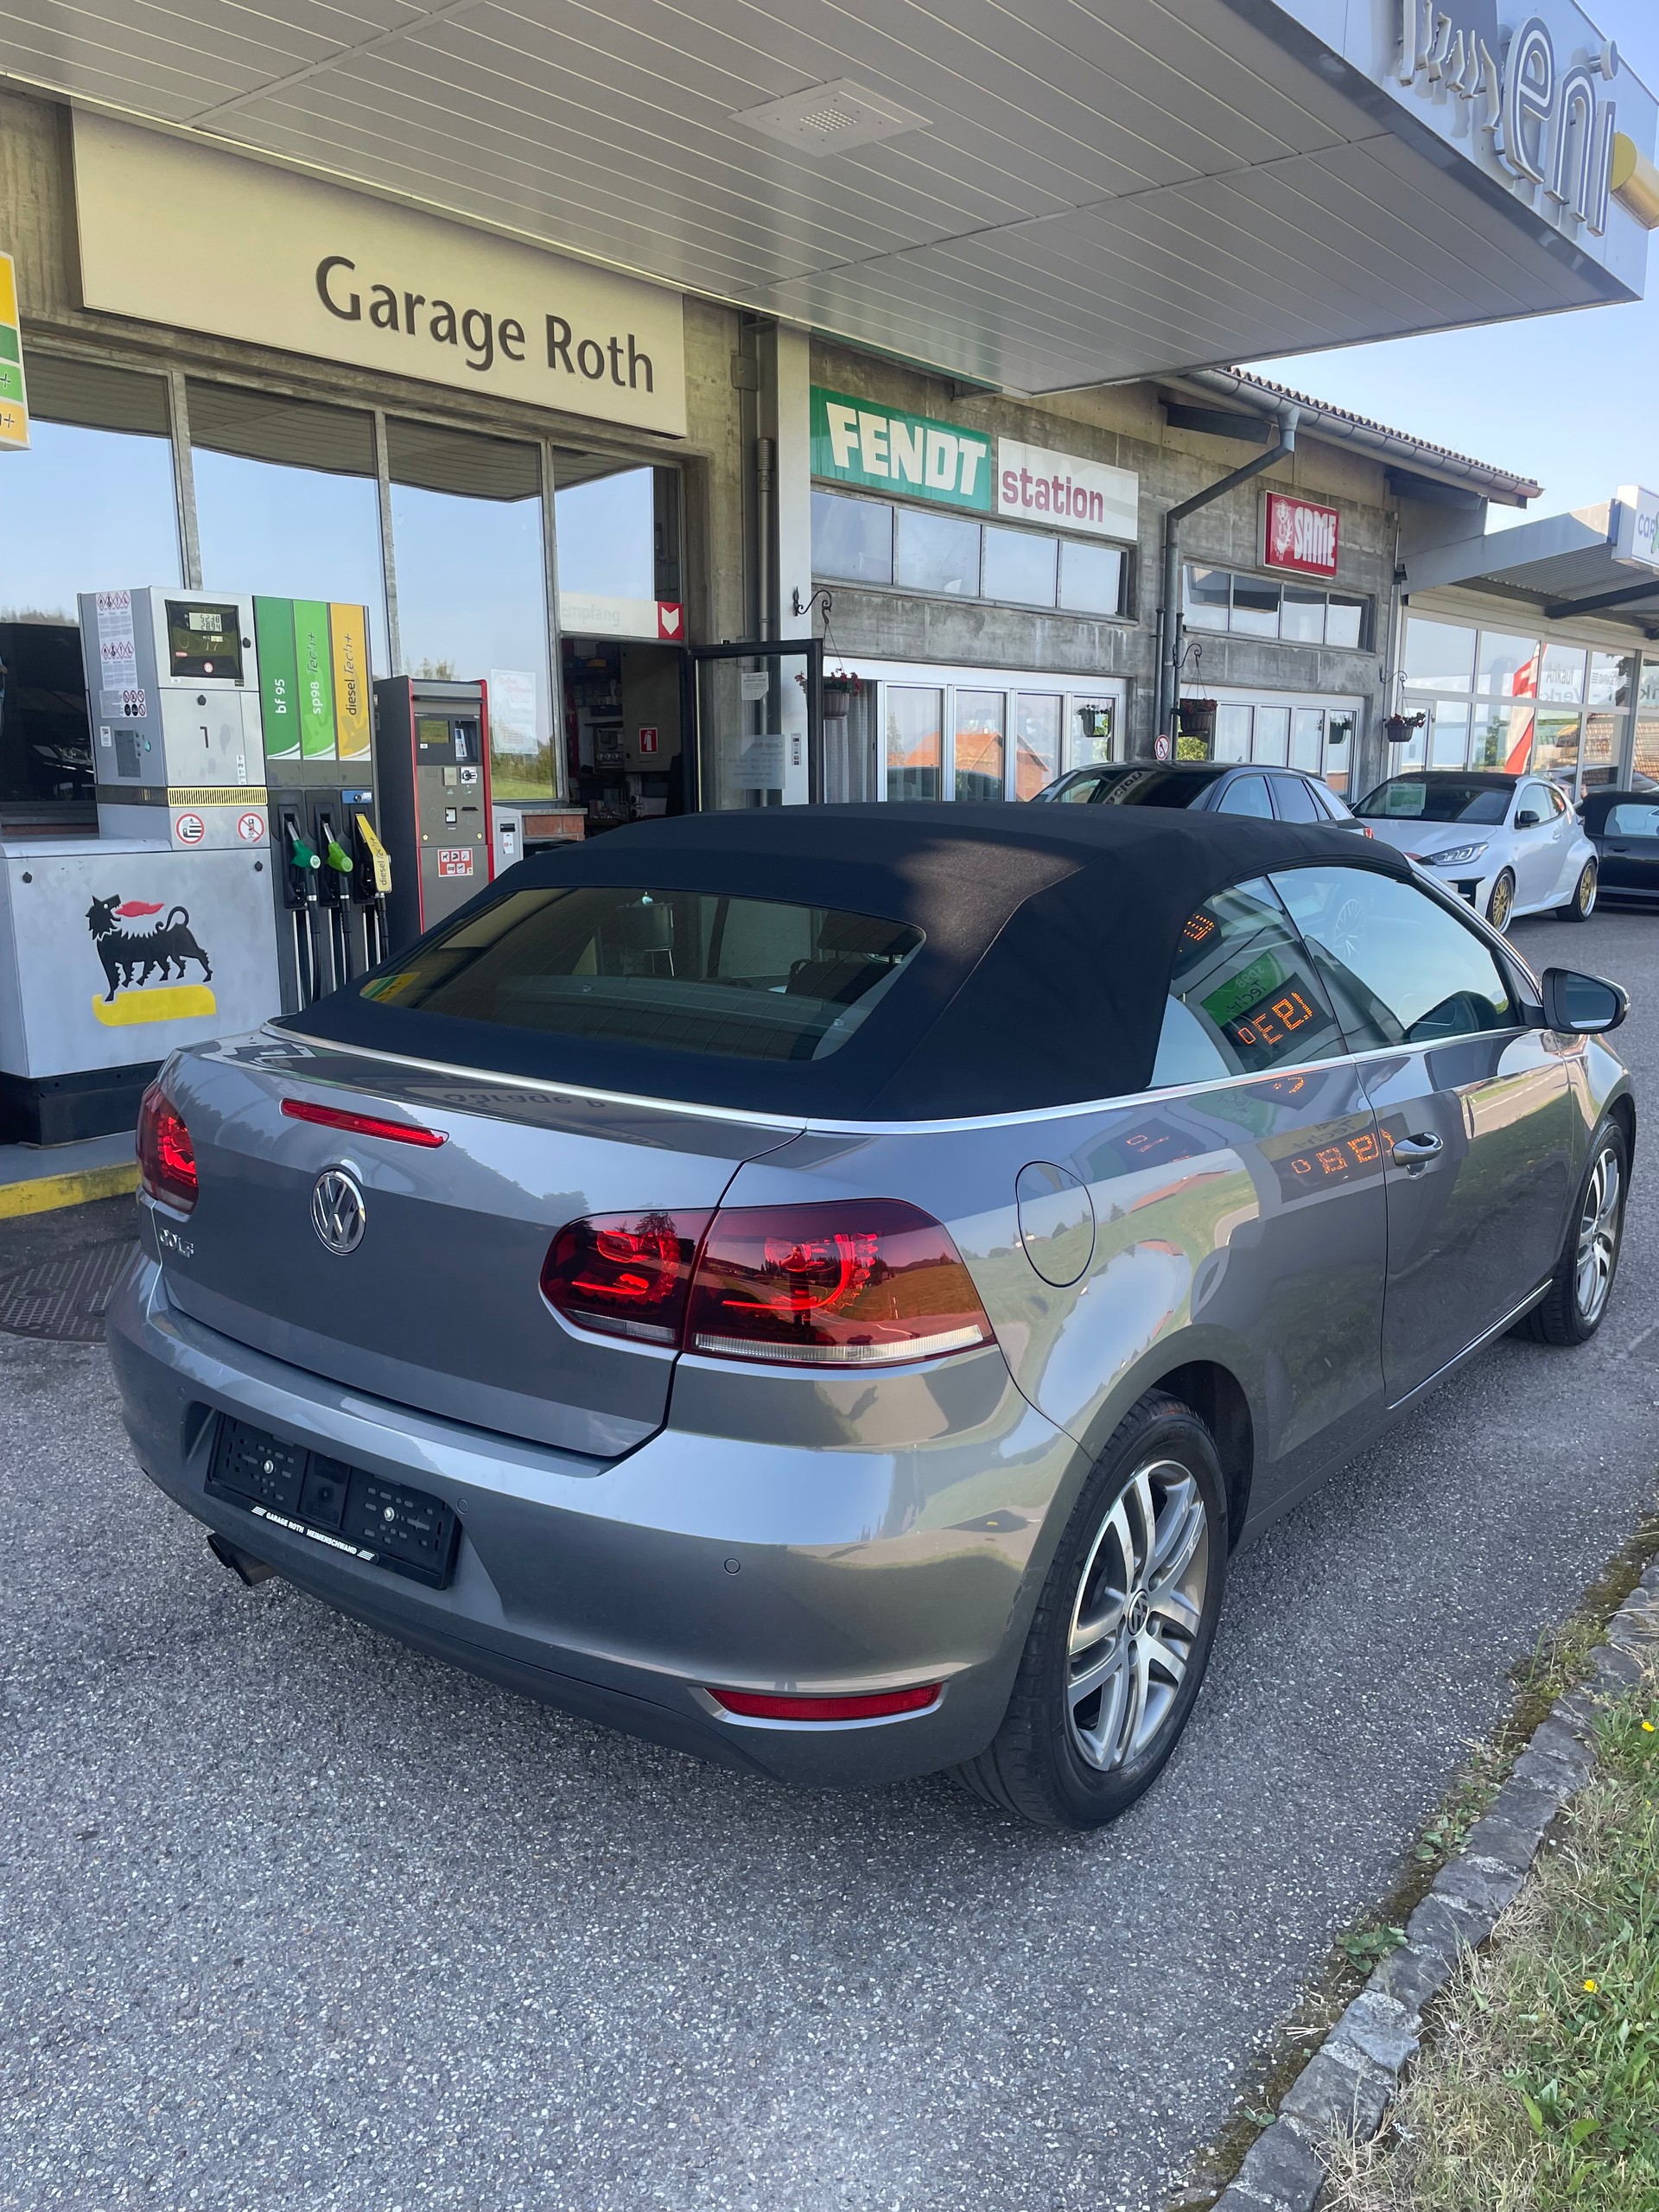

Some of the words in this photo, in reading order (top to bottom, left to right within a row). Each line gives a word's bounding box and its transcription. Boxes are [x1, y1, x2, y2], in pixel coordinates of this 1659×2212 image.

[315, 256, 525, 372] Garage
[546, 314, 654, 394] Roth
[826, 402, 986, 496] FENDT
[1002, 467, 1103, 523] station
[1294, 506, 1337, 567] SAME
[307, 631, 319, 673] Tech+
[343, 632, 354, 675] Tech+
[274, 678, 286, 695] 95
[275, 698, 287, 714] bf
[310, 681, 324, 715] sp98
[344, 679, 357, 715] diesel
[160, 1228, 194, 1258] GOLF
[265, 1512, 288, 1528] GARAGE
[288, 1521, 304, 1534] ROTH
[306, 1529, 358, 1555] HEIMENSCHWAND
